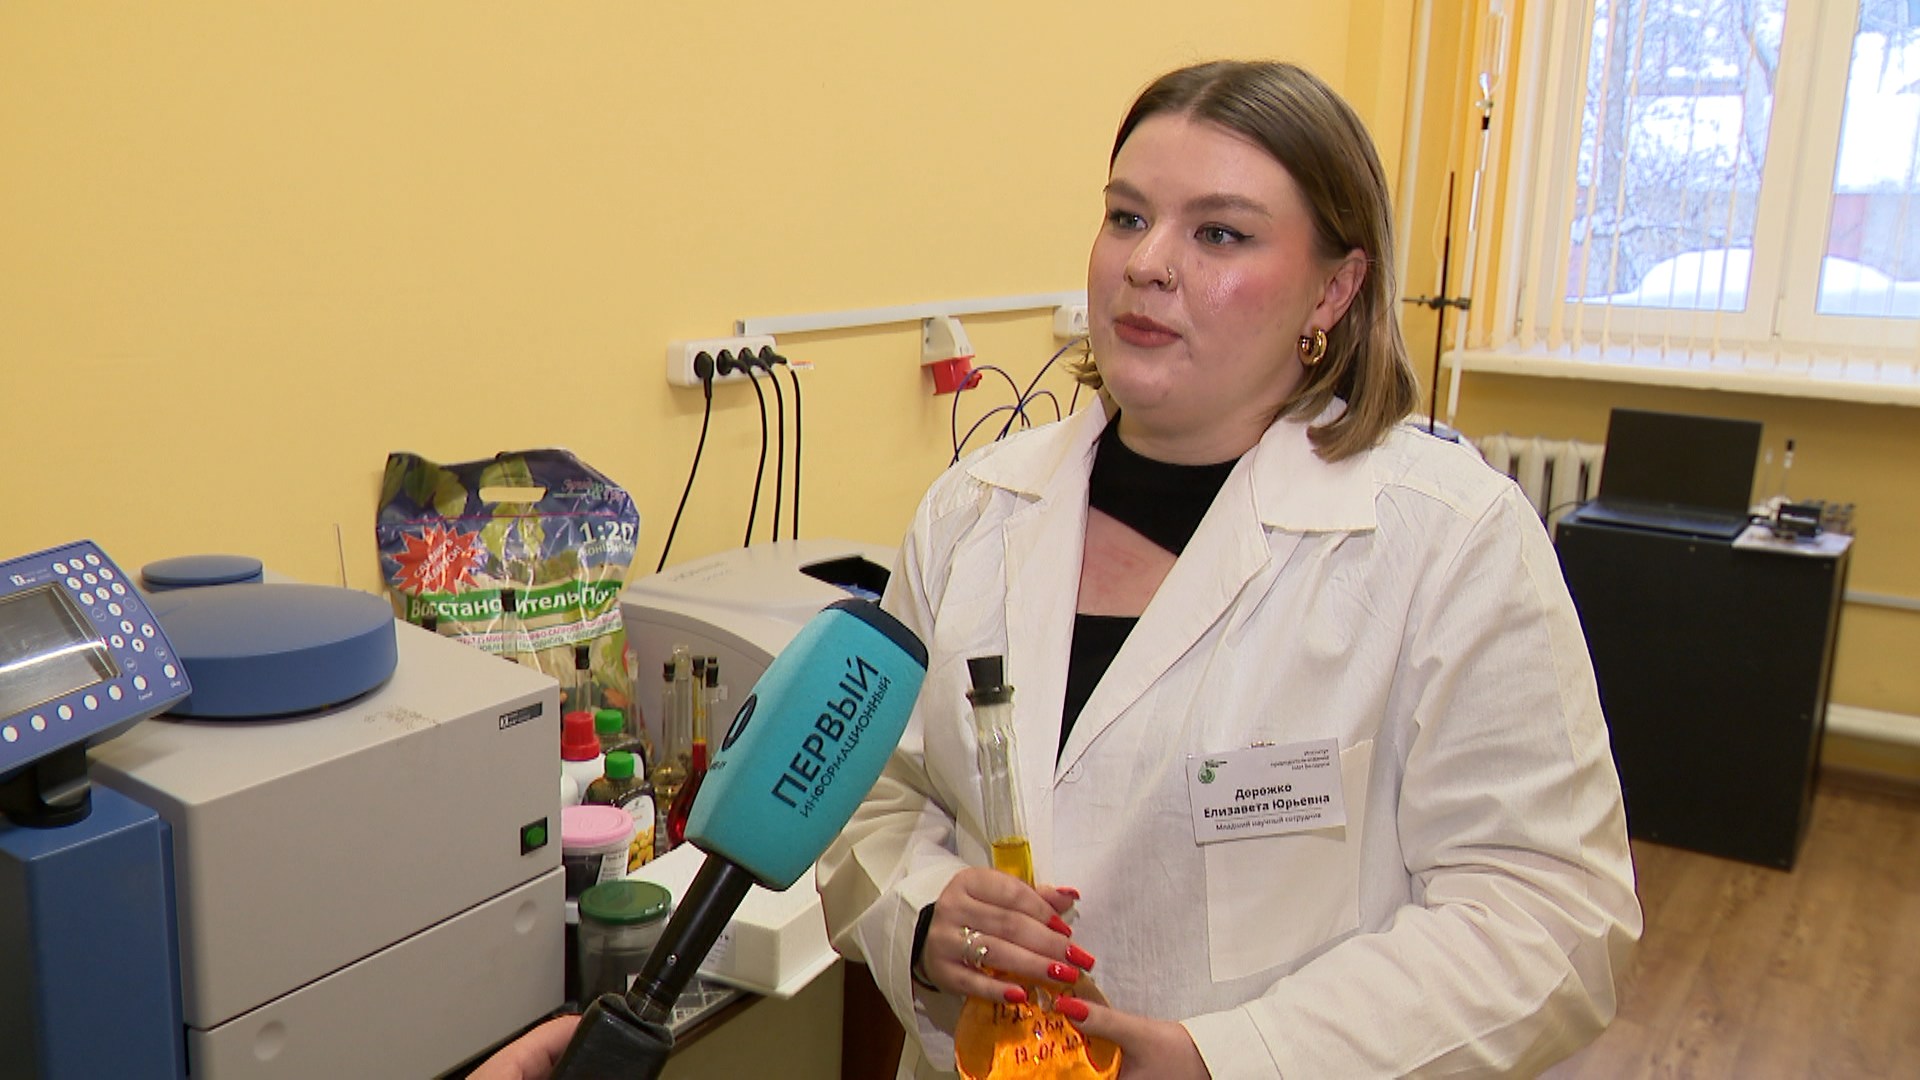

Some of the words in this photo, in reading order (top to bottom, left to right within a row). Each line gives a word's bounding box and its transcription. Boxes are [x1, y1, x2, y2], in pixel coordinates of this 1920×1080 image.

[580, 521, 634, 545] 1:20
[411, 591, 579, 618] Восстаноитель
[582, 586, 621, 606] По
[771, 654, 880, 809] ПЕРВЫЙ
[800, 676, 892, 818] ИНФОРМАЦИОННЫЙ
[1235, 783, 1292, 801] Дорожко
[1204, 803, 1270, 819] Елизавета
[1273, 794, 1330, 811] Юрьевна
[1216, 819, 1251, 831] Младший
[1252, 817, 1284, 828] научный
[1285, 812, 1321, 825] сотрудник
